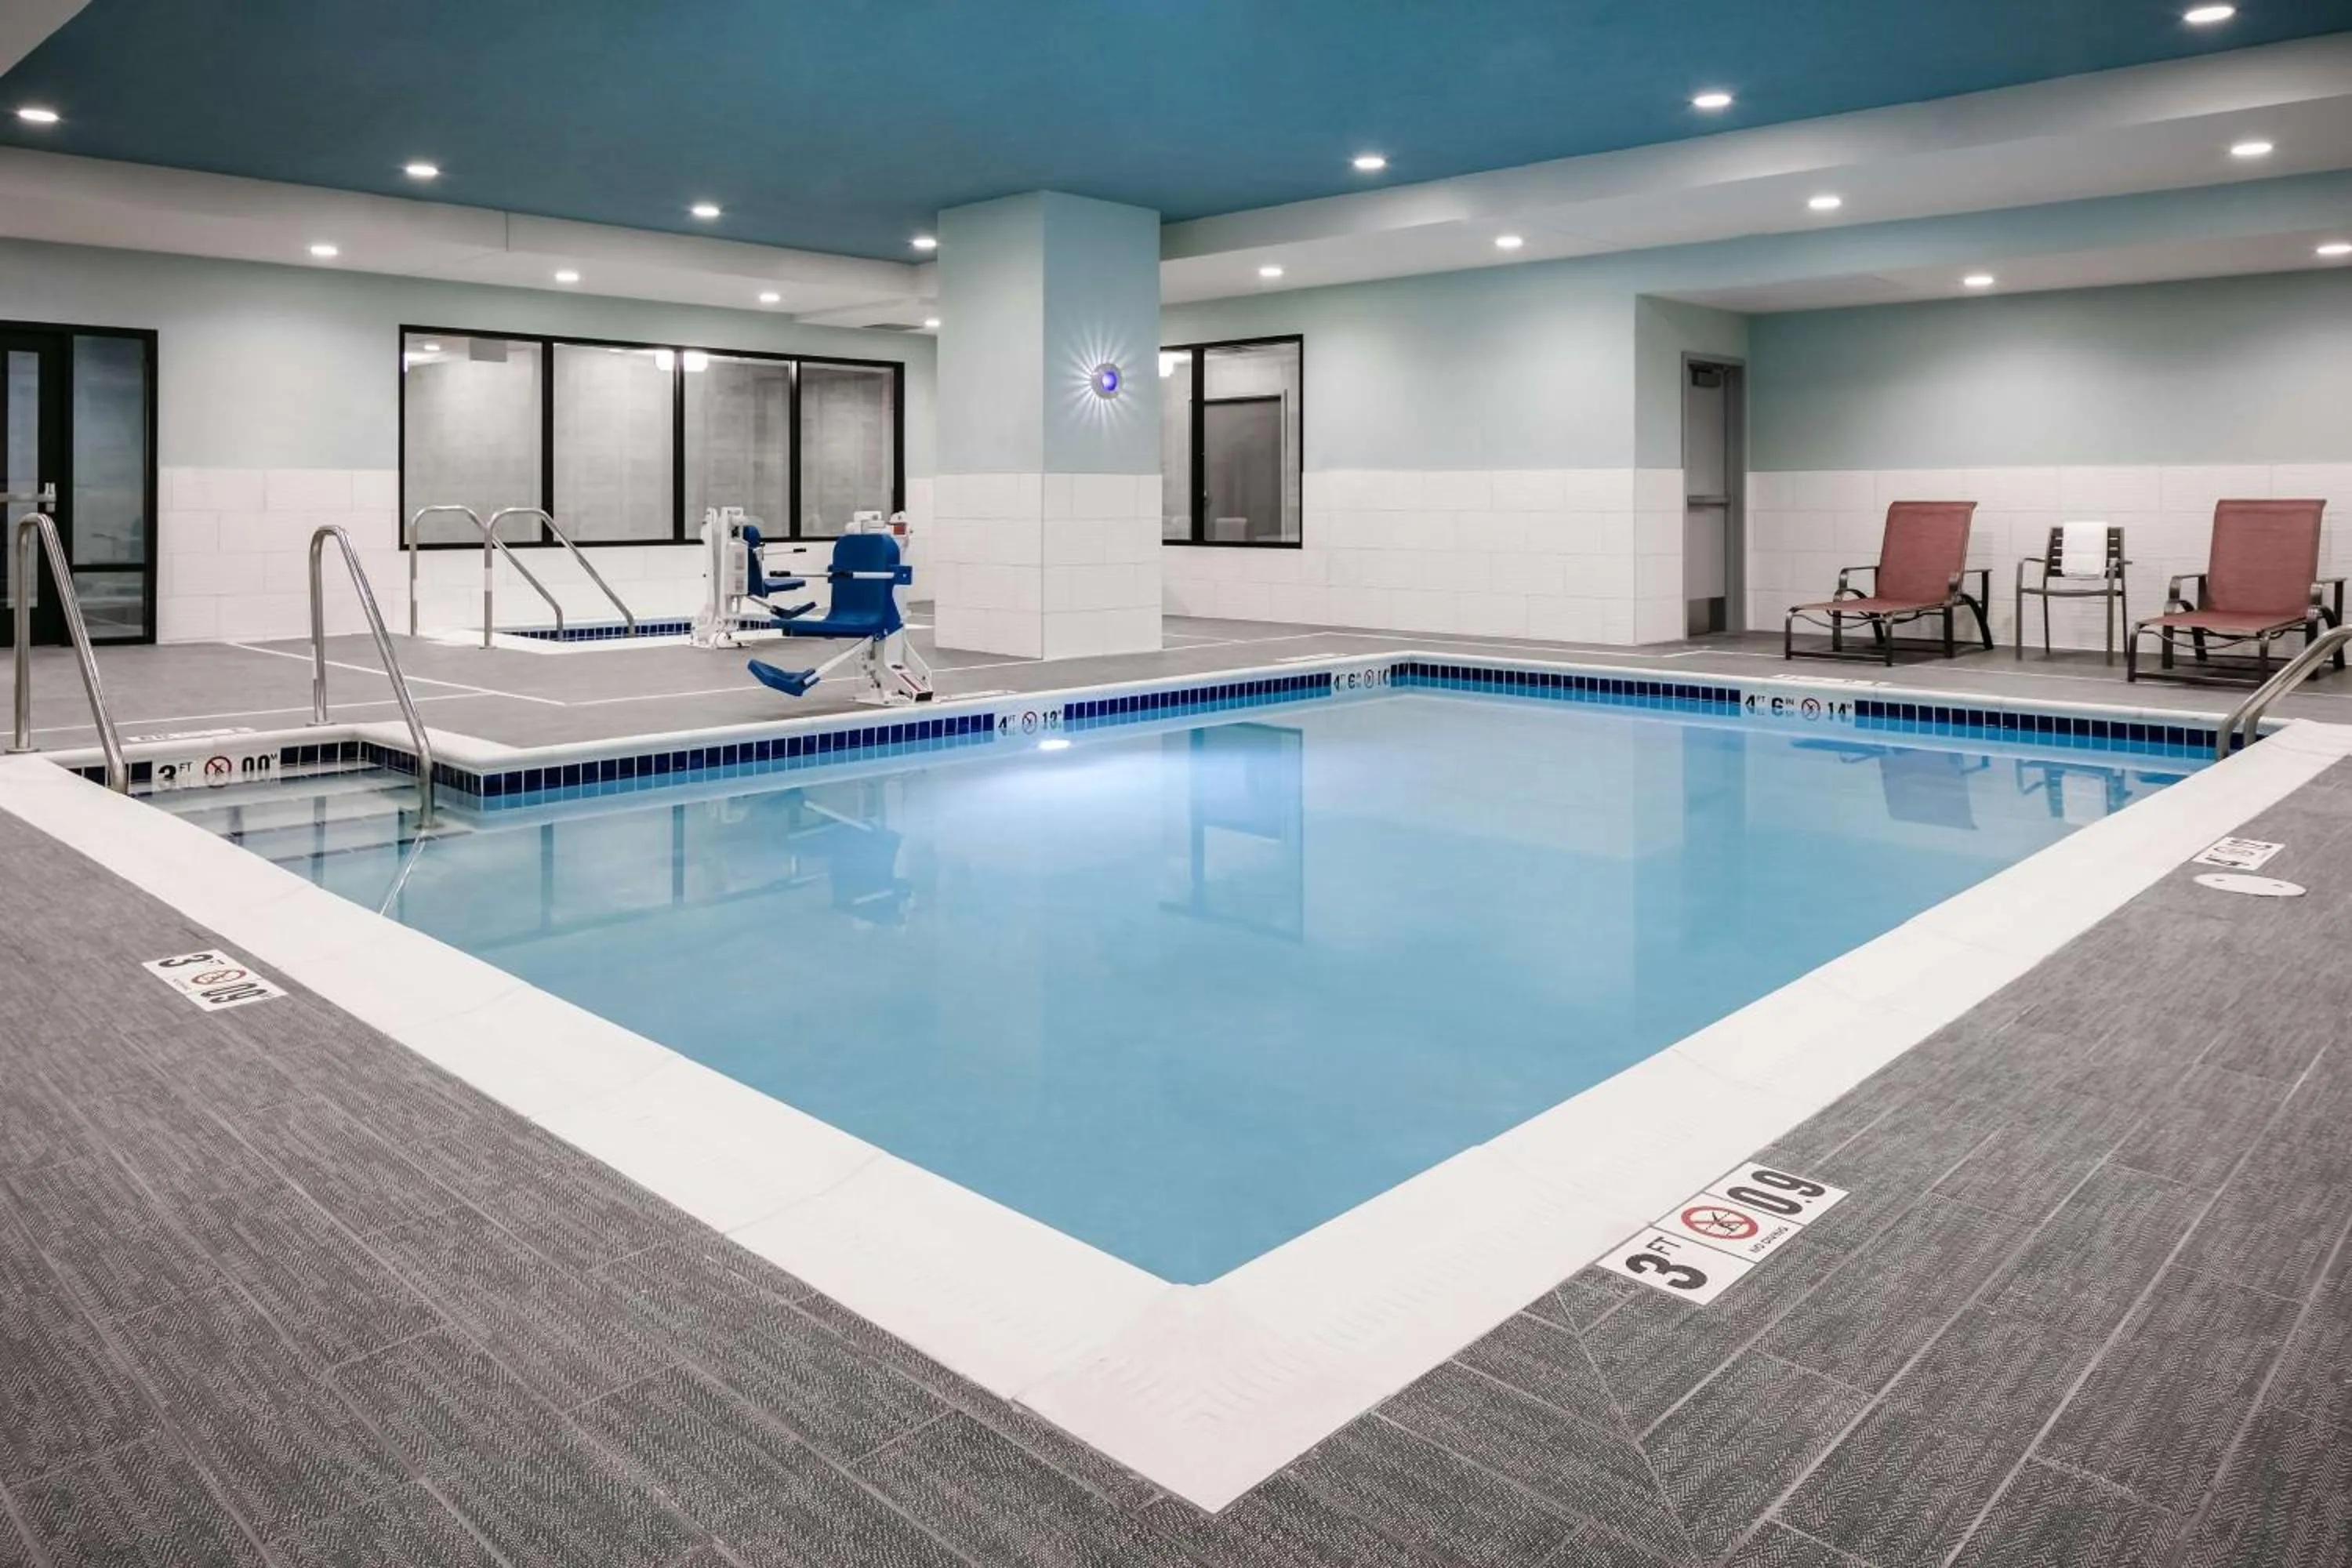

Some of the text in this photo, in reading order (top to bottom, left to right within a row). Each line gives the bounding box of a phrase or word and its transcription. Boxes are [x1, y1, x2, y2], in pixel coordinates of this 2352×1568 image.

[158, 953, 214, 968] 3
[1625, 1169, 1827, 1290] 3 FT 0.9
